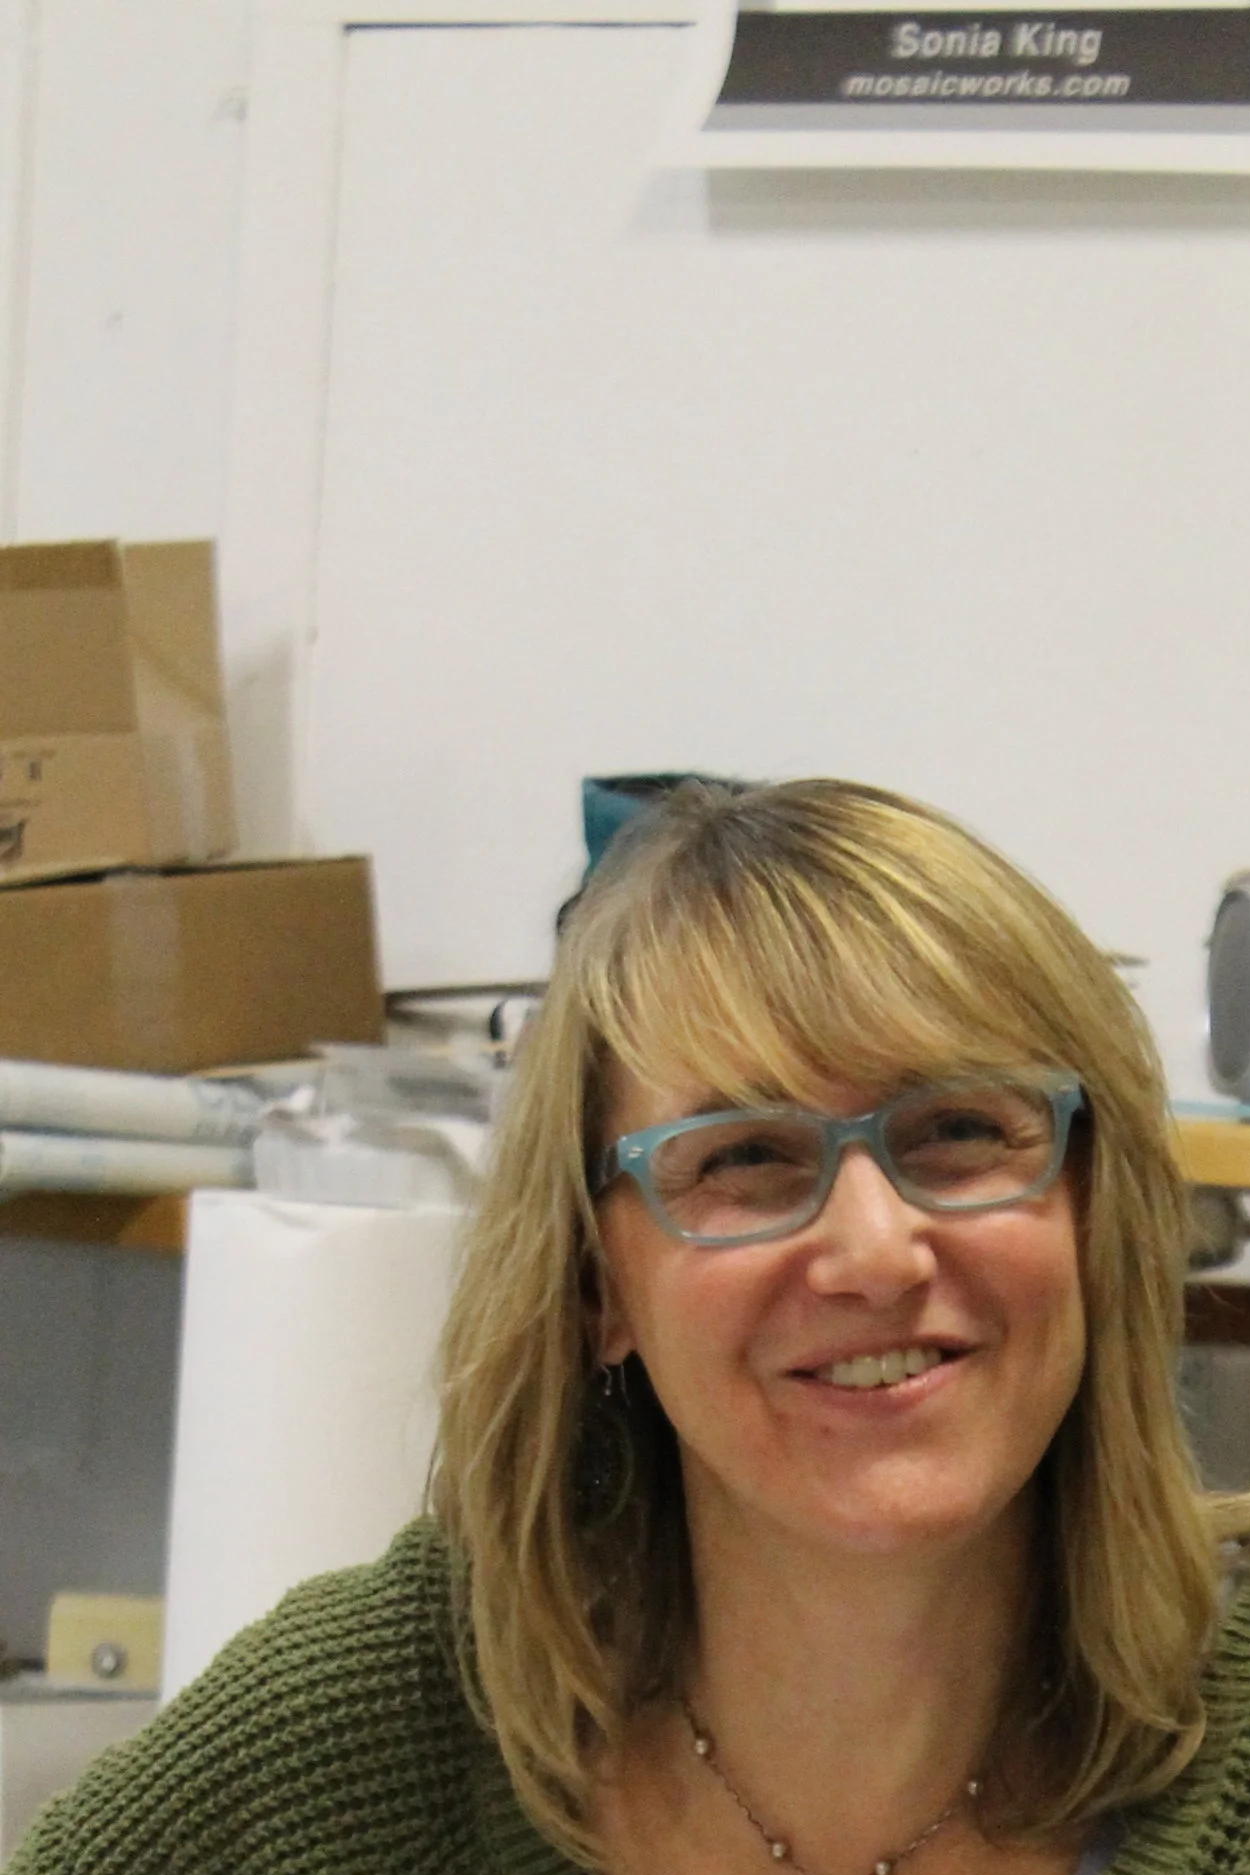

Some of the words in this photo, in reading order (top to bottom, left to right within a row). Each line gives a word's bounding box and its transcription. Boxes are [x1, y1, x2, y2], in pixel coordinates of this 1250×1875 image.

[893, 21, 1002, 58] Sonia
[1013, 22, 1103, 66] King
[845, 70, 1131, 97] mosaicworks.com
